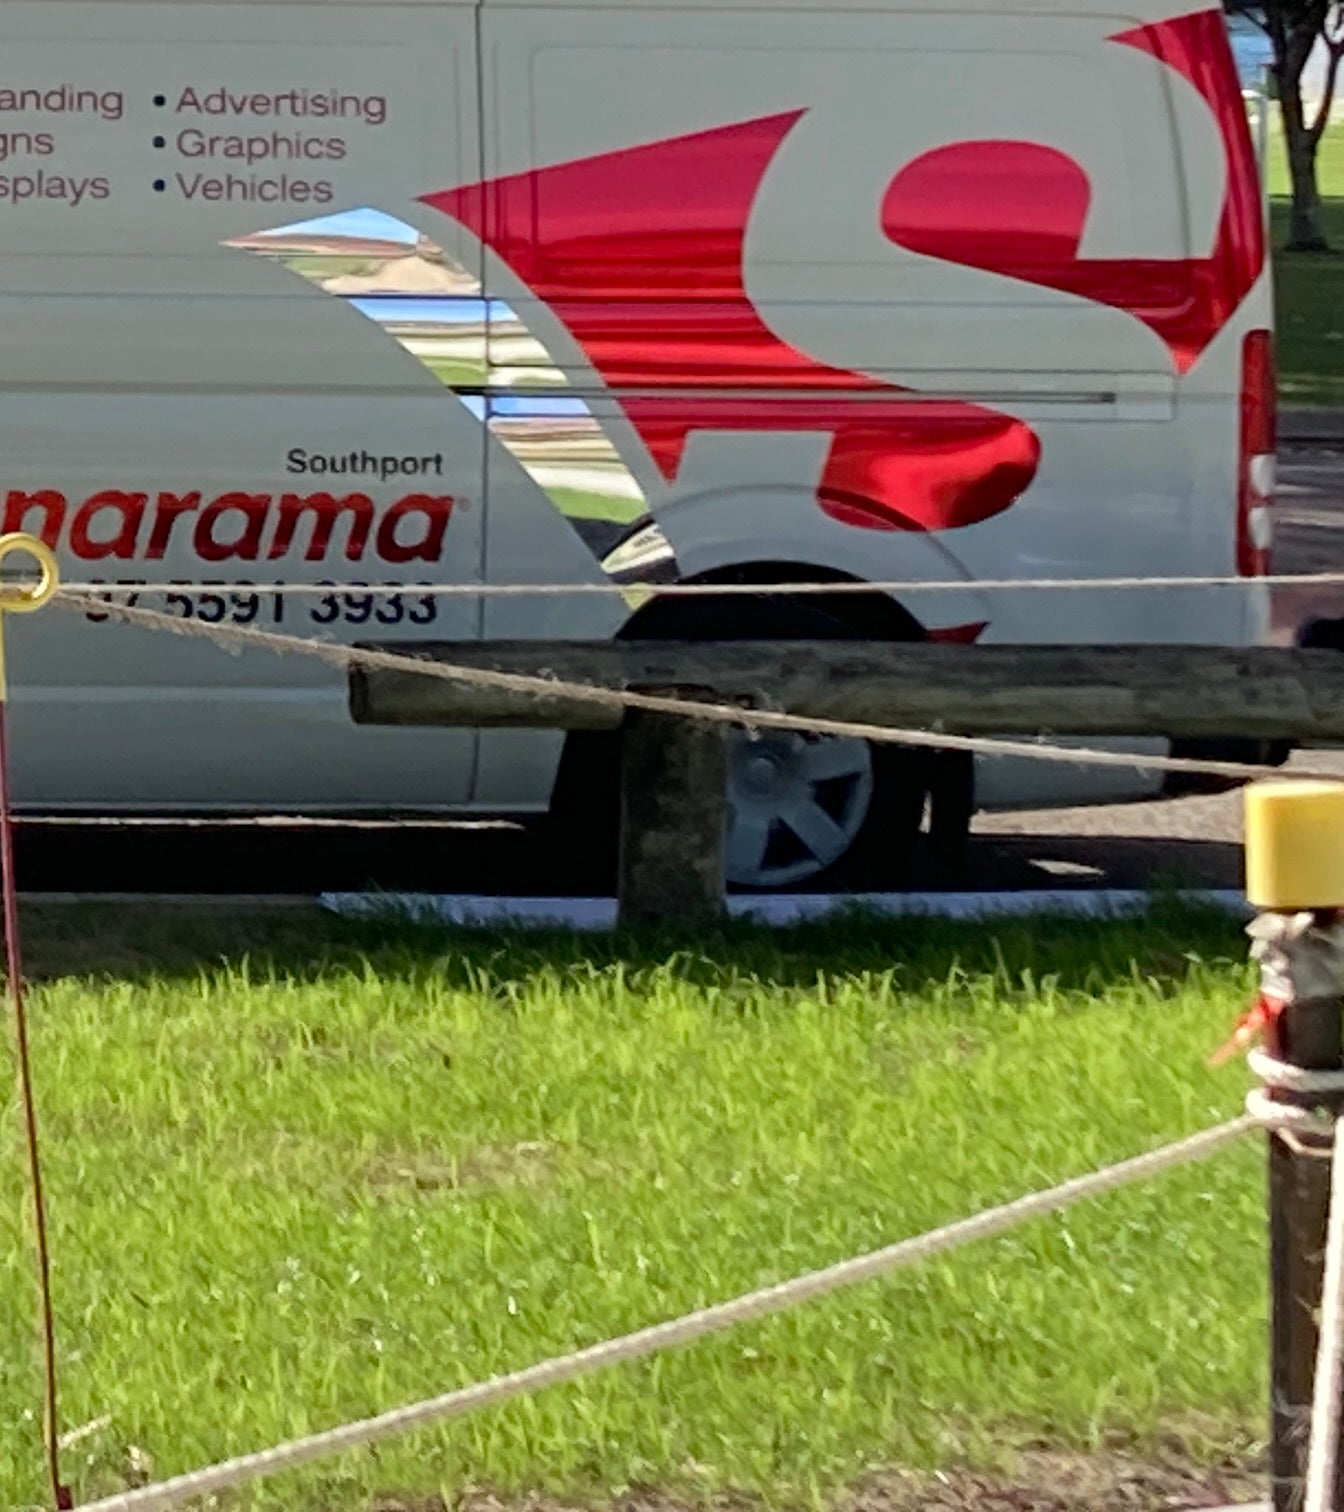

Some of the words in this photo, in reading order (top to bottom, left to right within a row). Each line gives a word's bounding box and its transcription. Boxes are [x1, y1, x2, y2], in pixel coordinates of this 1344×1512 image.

[175, 86, 386, 125] Advertising
[176, 128, 346, 166] Graphics
[175, 172, 333, 203] Vehicles
[287, 449, 443, 481] Southport
[165, 579, 285, 623] 5591
[310, 580, 437, 623] 3933
